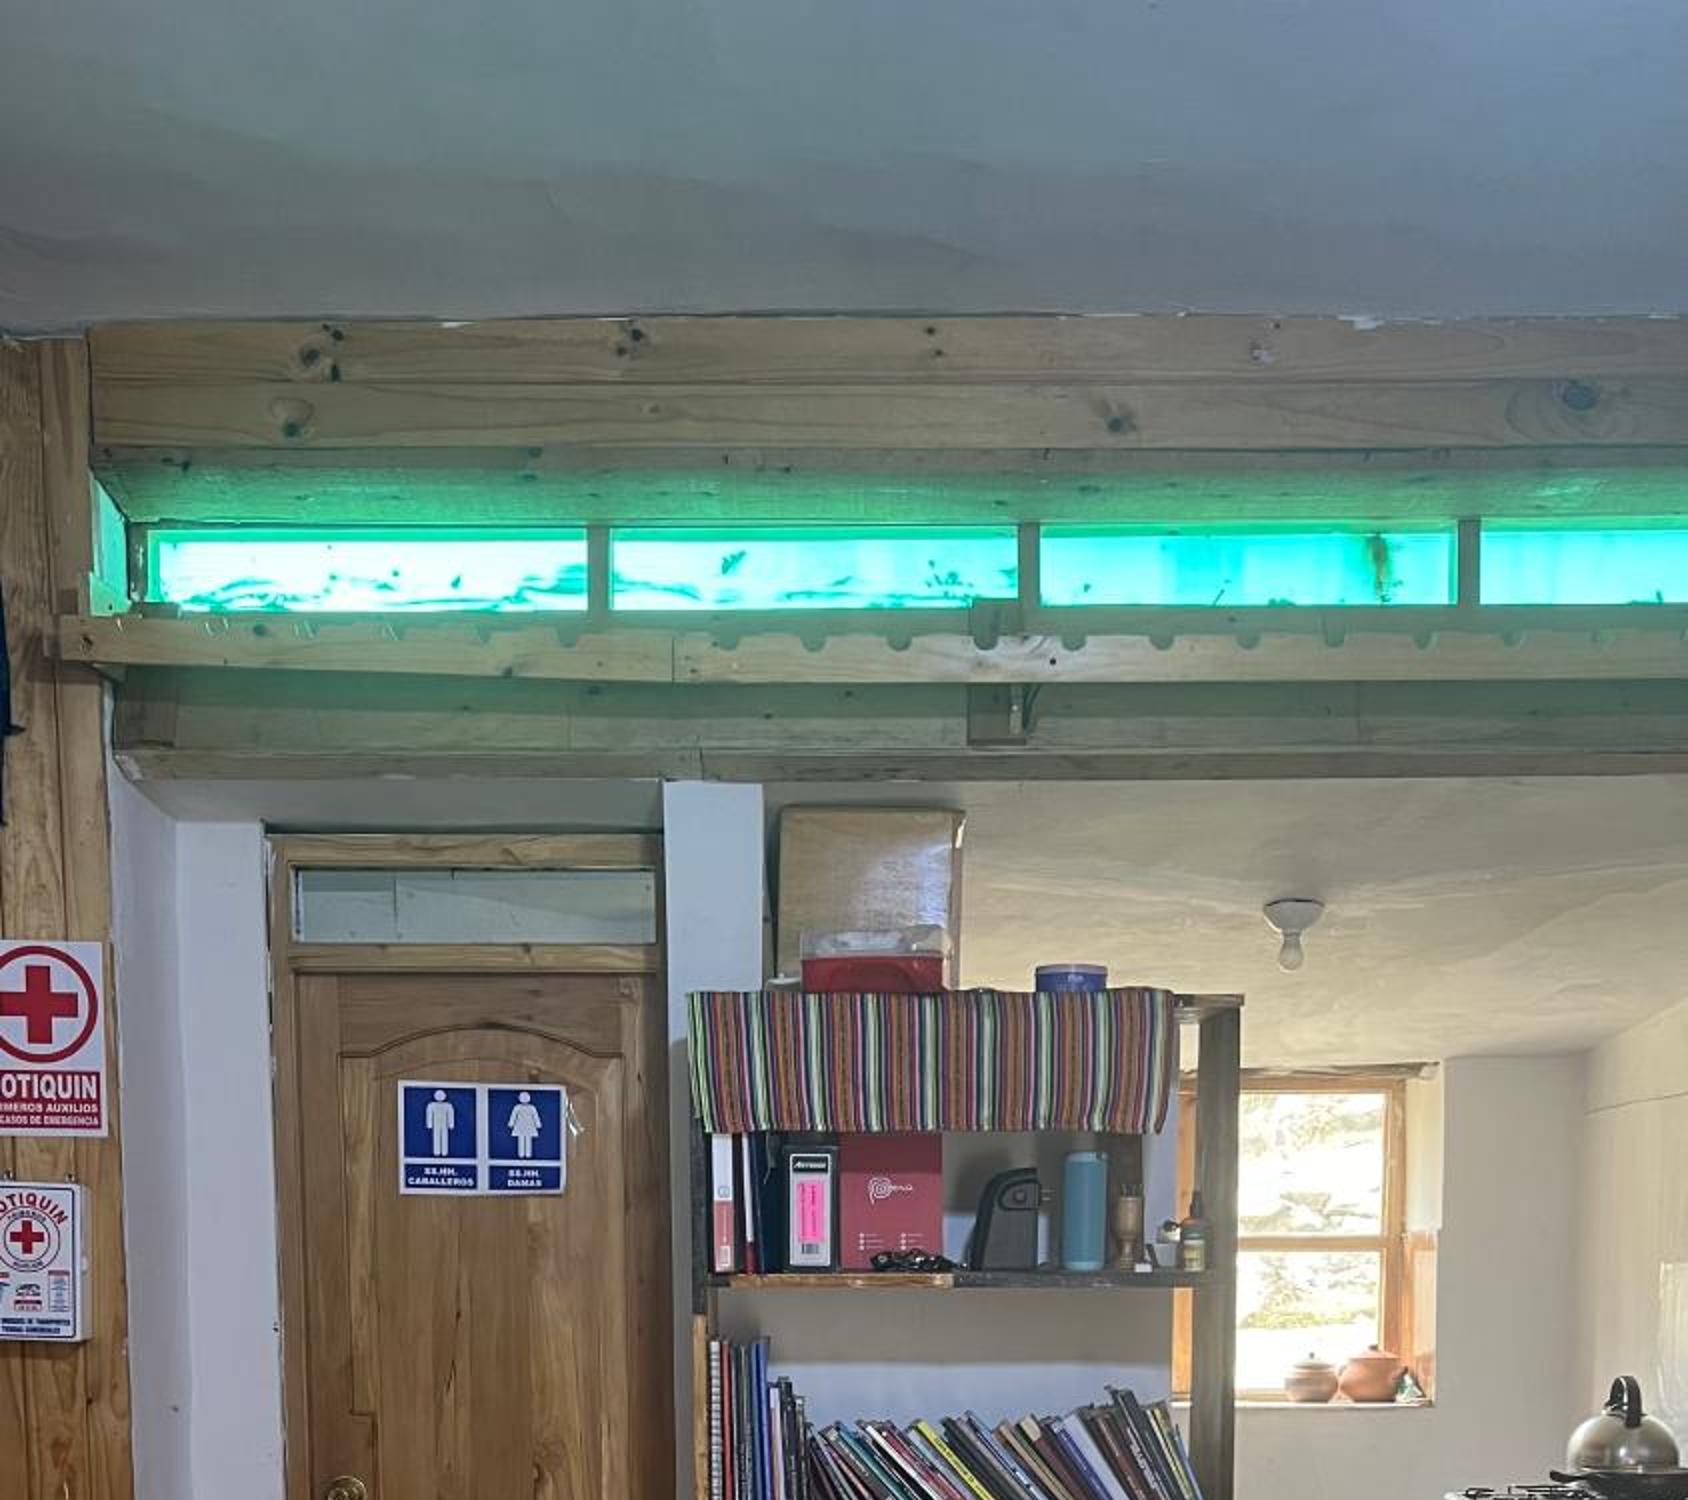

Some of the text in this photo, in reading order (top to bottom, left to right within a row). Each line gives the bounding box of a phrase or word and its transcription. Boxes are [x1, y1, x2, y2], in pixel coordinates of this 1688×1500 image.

[0, 1073, 97, 1101] OTIQUIN
[46, 1103, 99, 1113] AUXILIOS
[30, 1115, 42, 1125] DE
[407, 1177, 475, 1187] CABALLEROS
[507, 1179, 542, 1188] DAMAS
[0, 1192, 69, 1225] OTIQUIN
